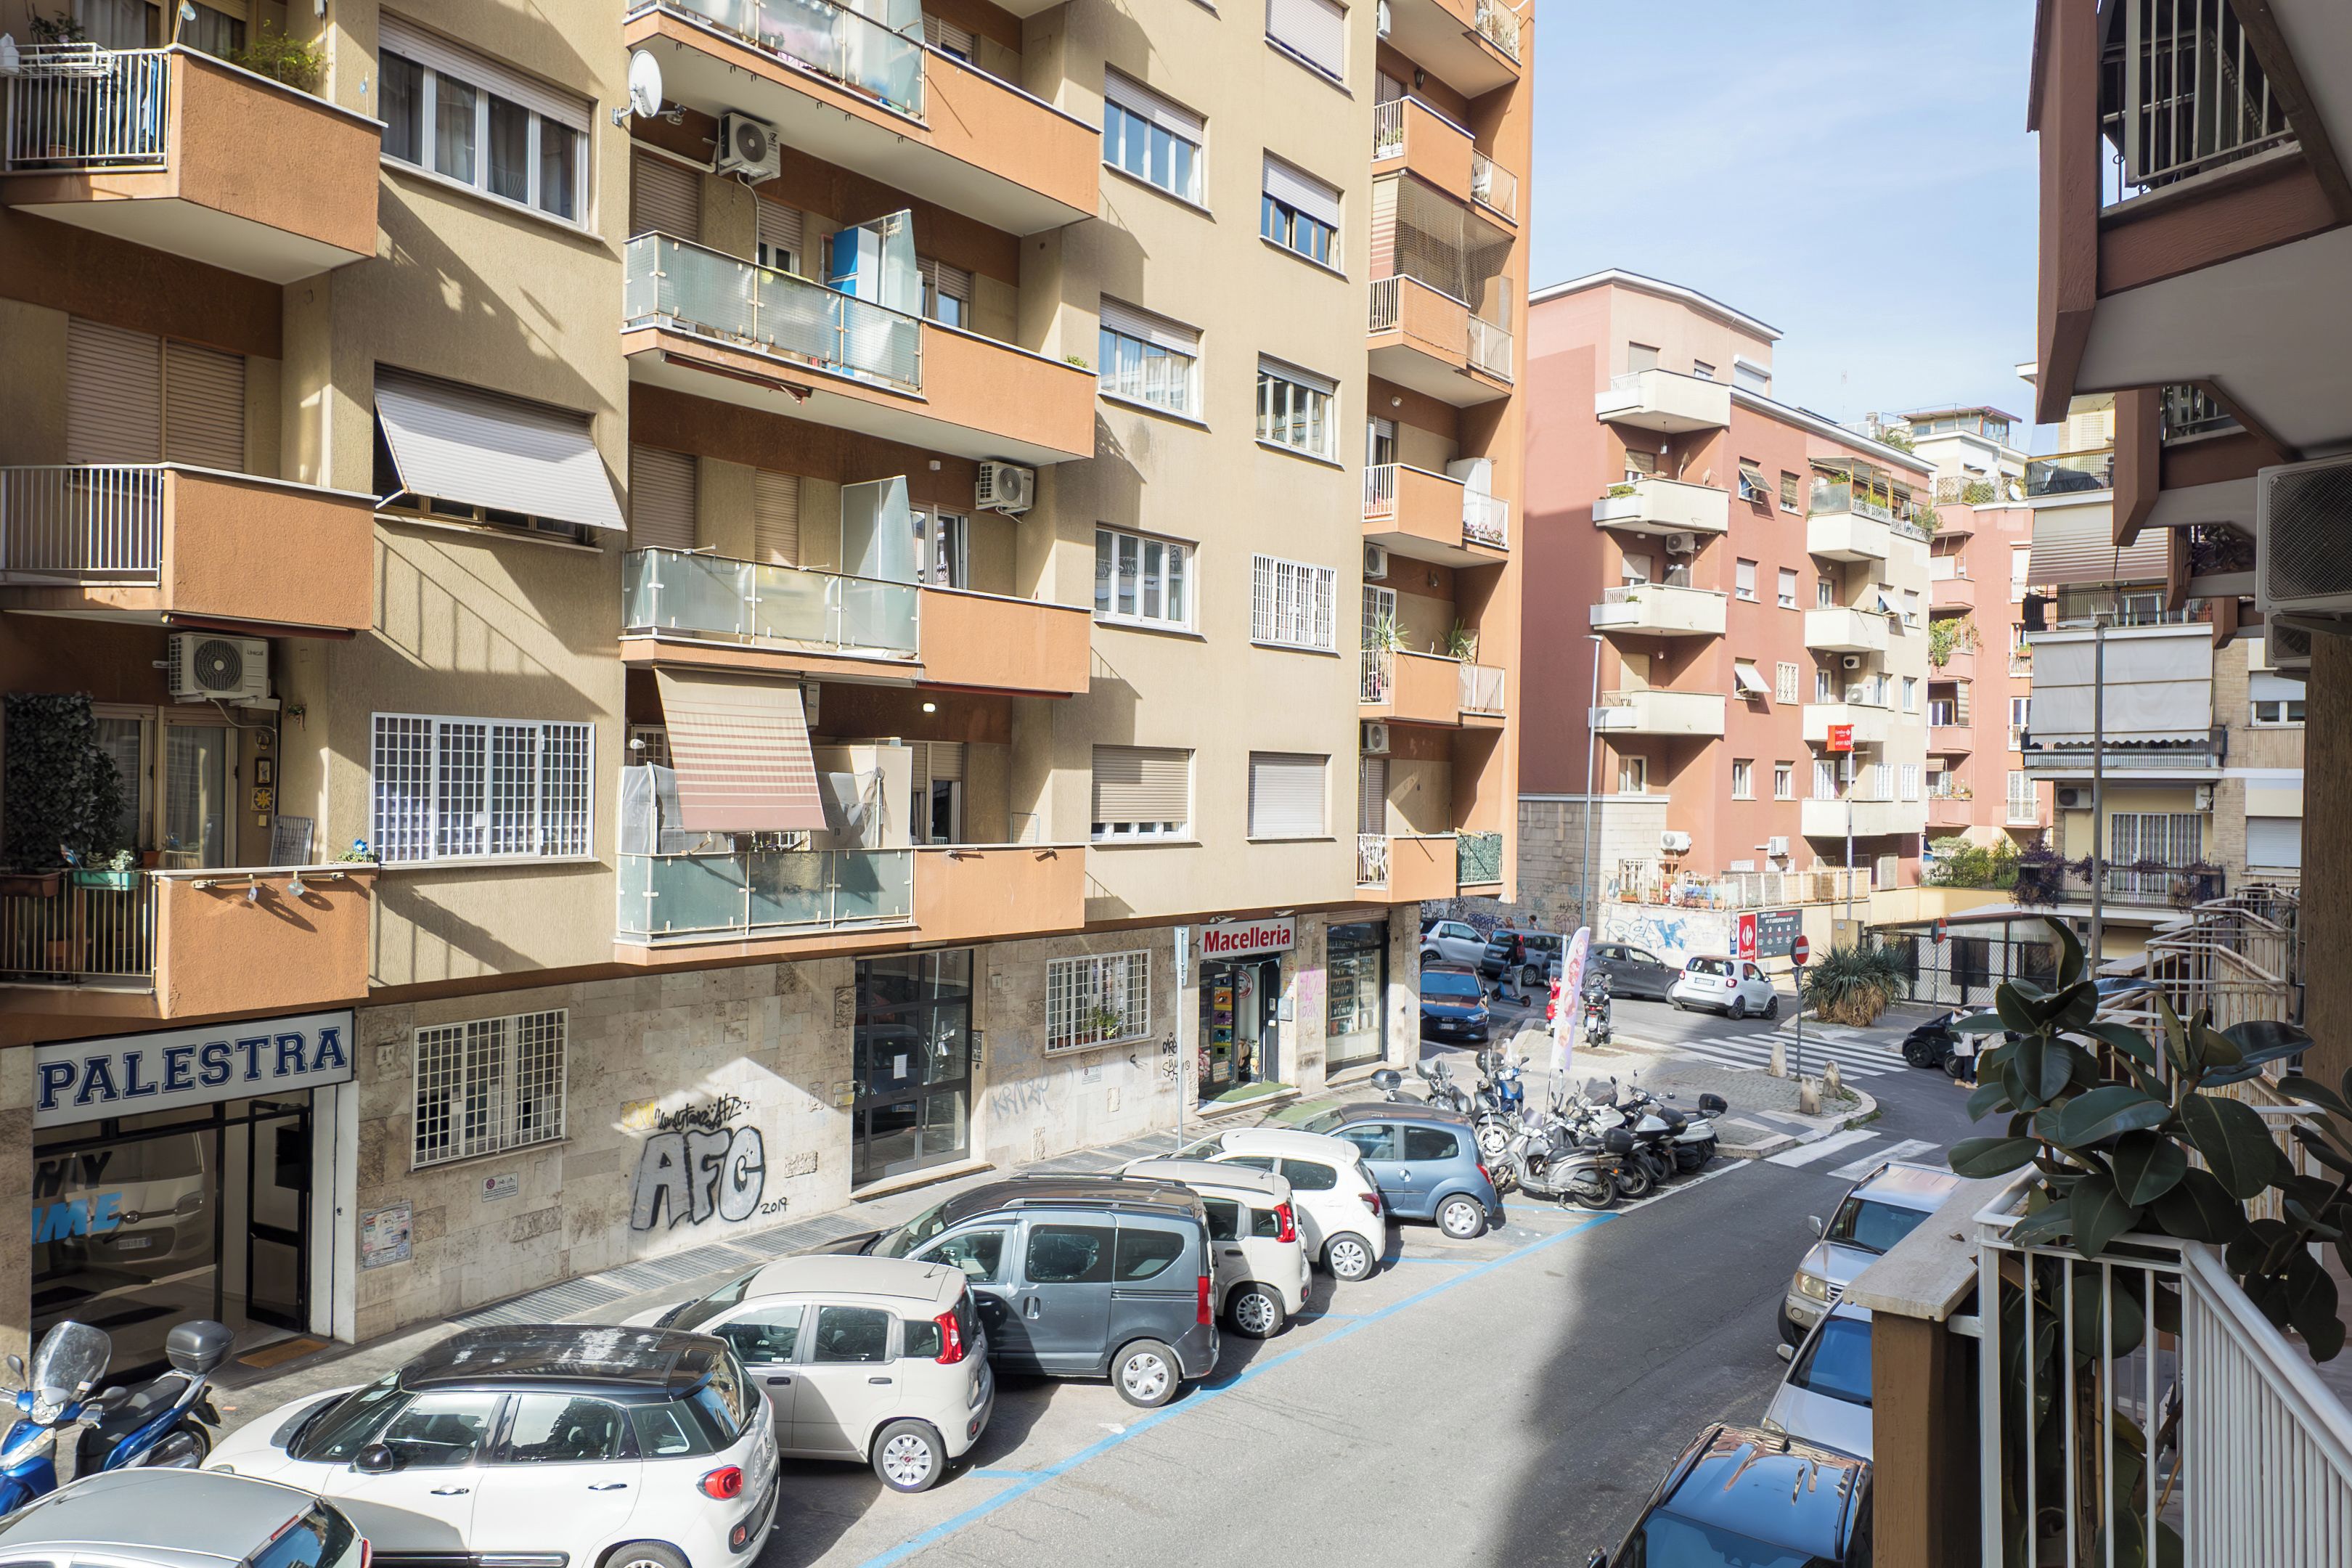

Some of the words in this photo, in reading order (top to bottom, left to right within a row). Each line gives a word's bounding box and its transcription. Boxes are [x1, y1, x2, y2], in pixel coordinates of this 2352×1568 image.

[1204, 924, 1291, 953] Macelleria
[37, 1026, 347, 1112] PALESTRA
[761, 1197, 790, 1214] 2019
